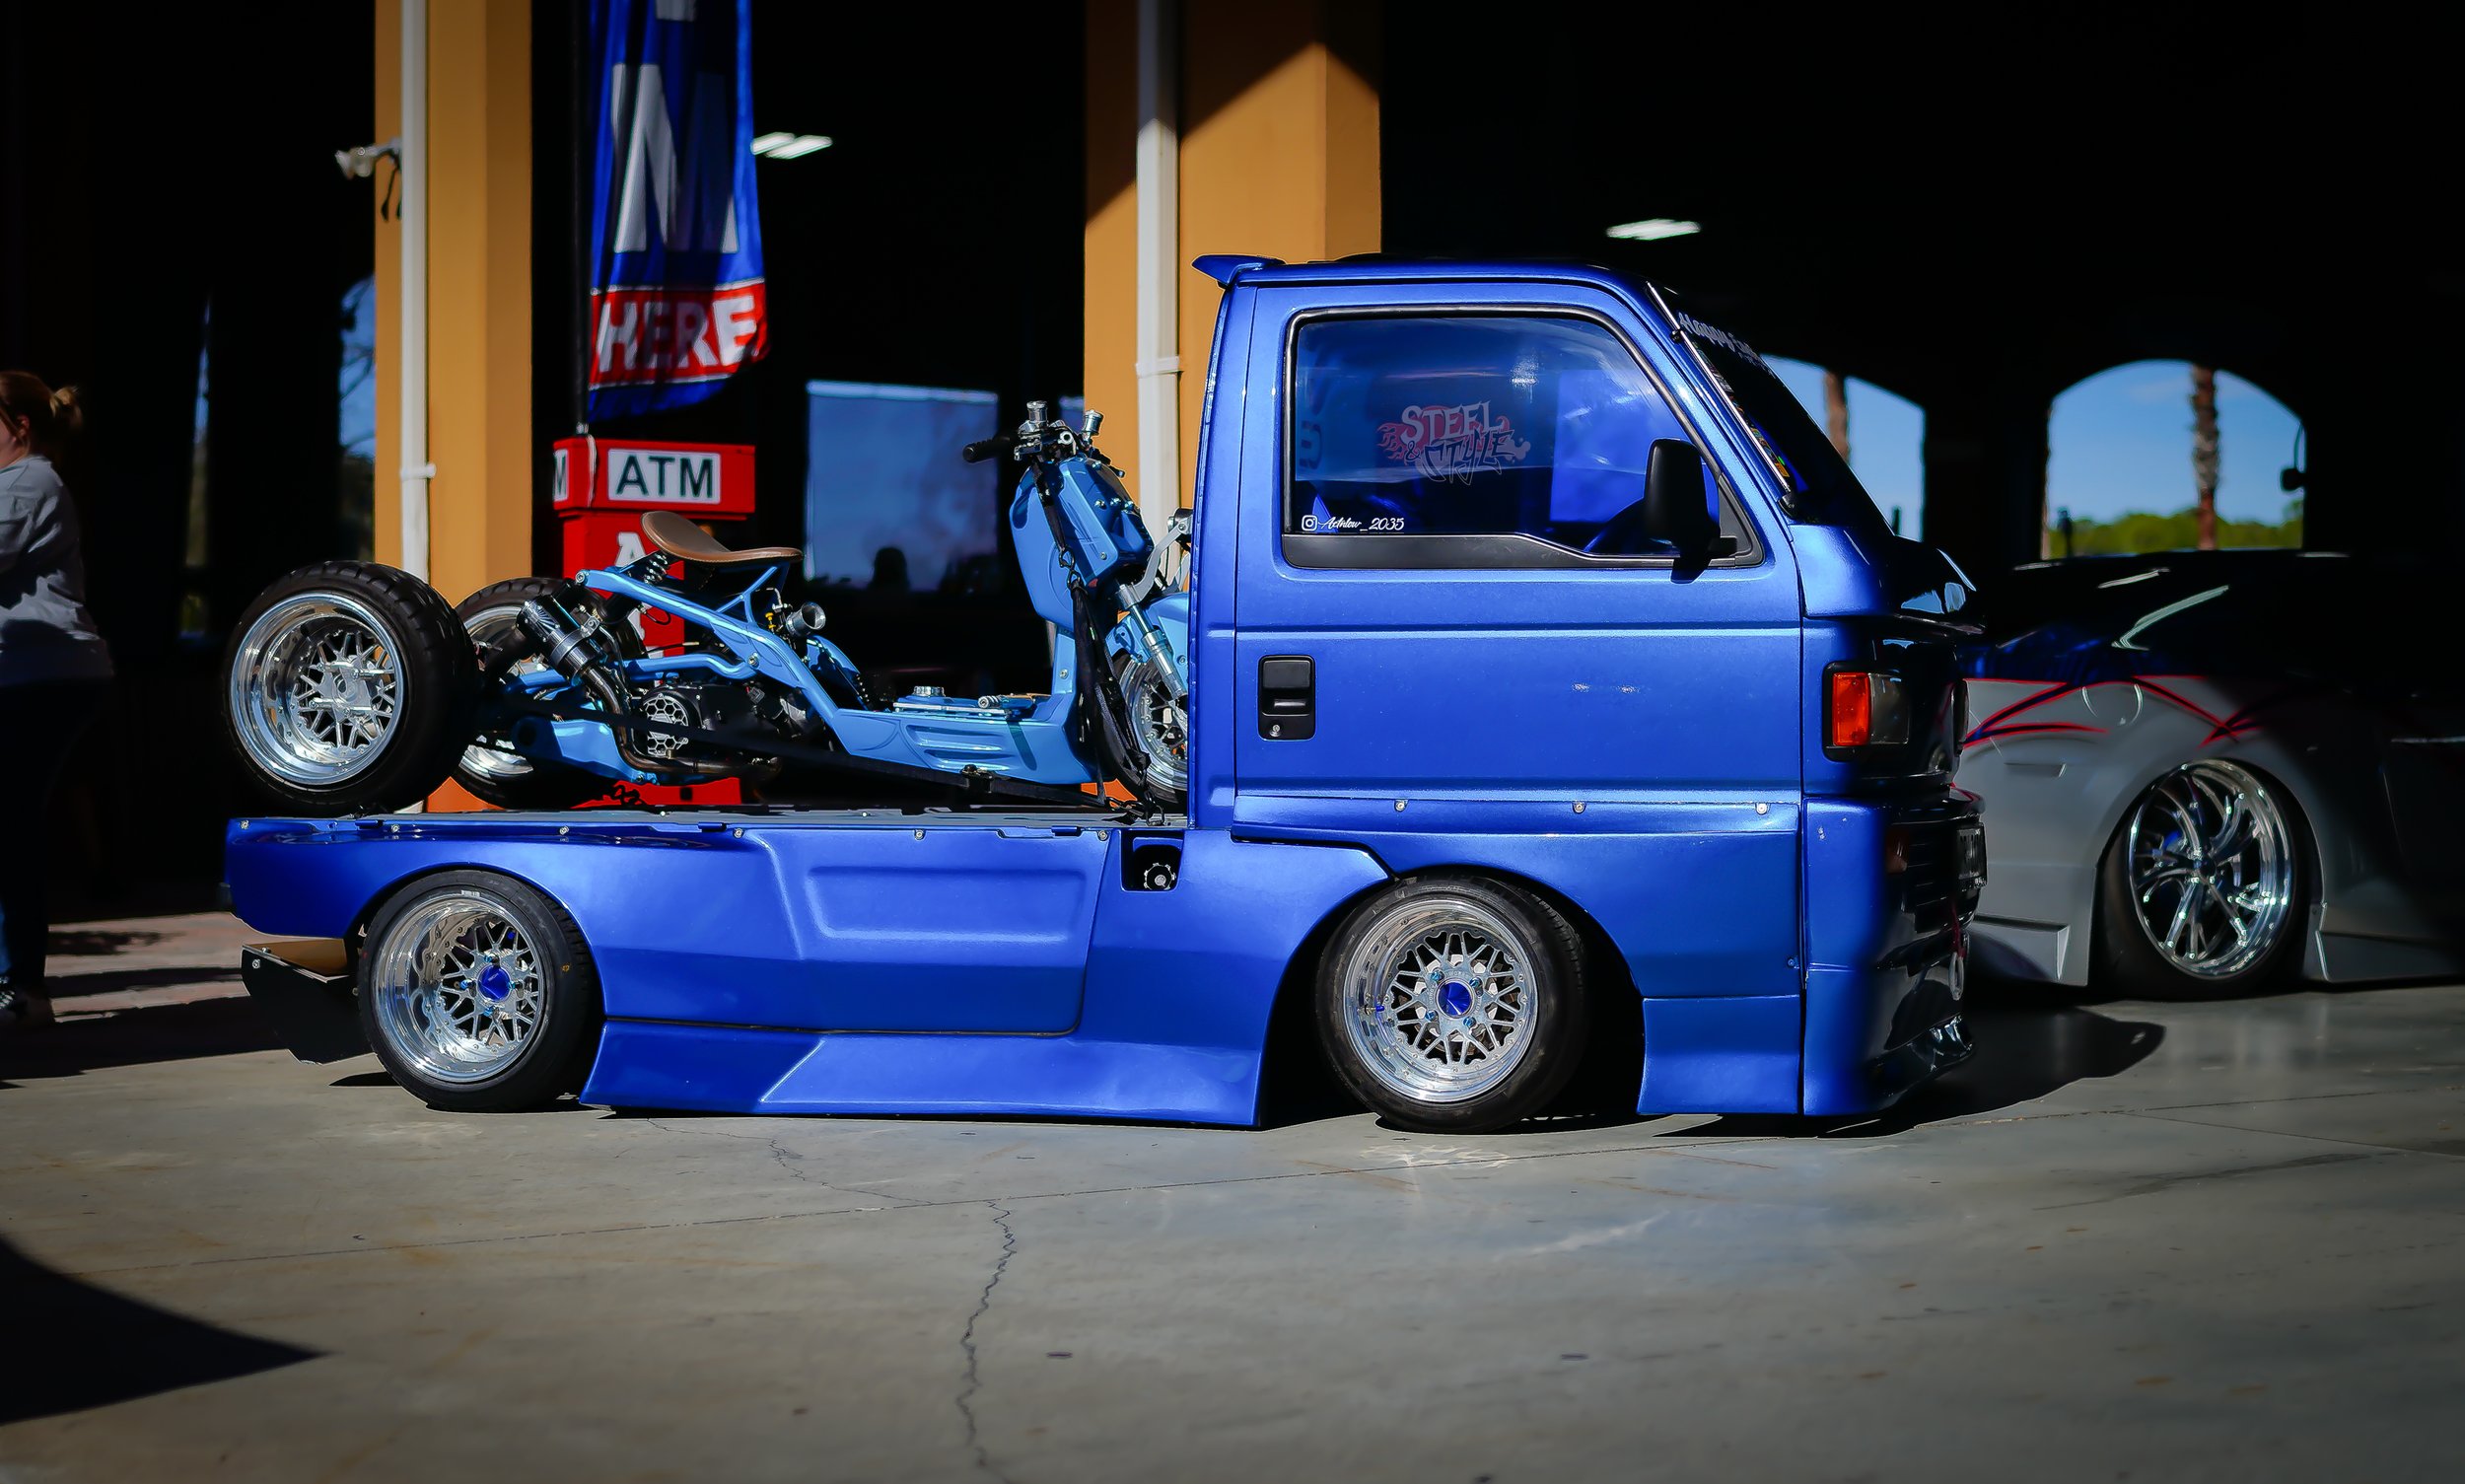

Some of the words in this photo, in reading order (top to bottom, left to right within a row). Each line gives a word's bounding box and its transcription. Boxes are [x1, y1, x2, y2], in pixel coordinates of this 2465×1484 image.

[597, 294, 758, 373] HERE
[1400, 400, 1505, 445] STEEL
[616, 454, 713, 498] ATM
